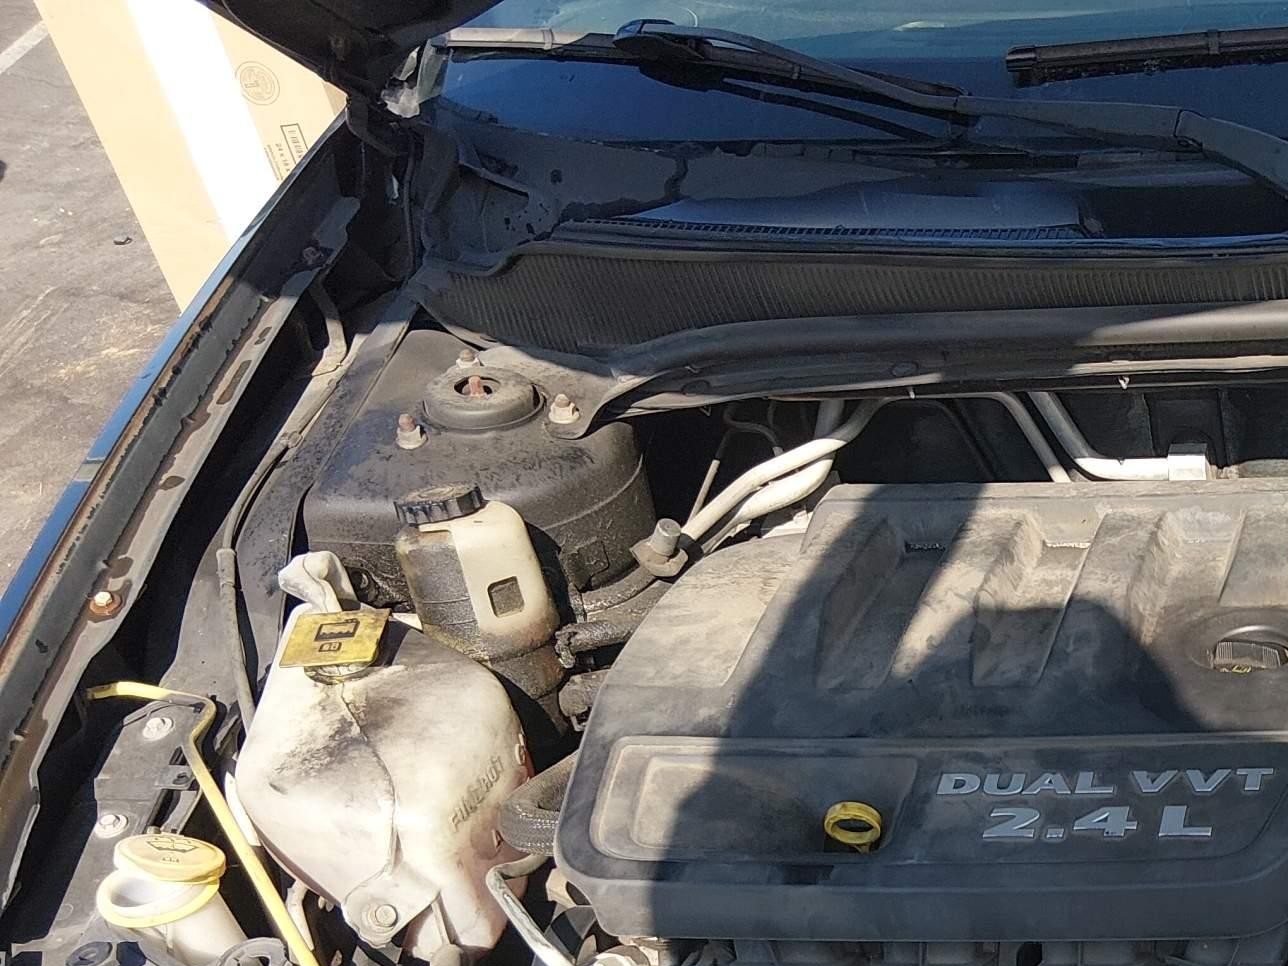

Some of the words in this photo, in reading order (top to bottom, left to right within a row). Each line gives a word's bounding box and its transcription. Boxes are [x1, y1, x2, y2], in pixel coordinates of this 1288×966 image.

[936, 770, 1115, 796] DUAL
[1132, 768, 1274, 793] VVT
[982, 806, 1138, 839] 2.4
[1158, 805, 1213, 838] L
